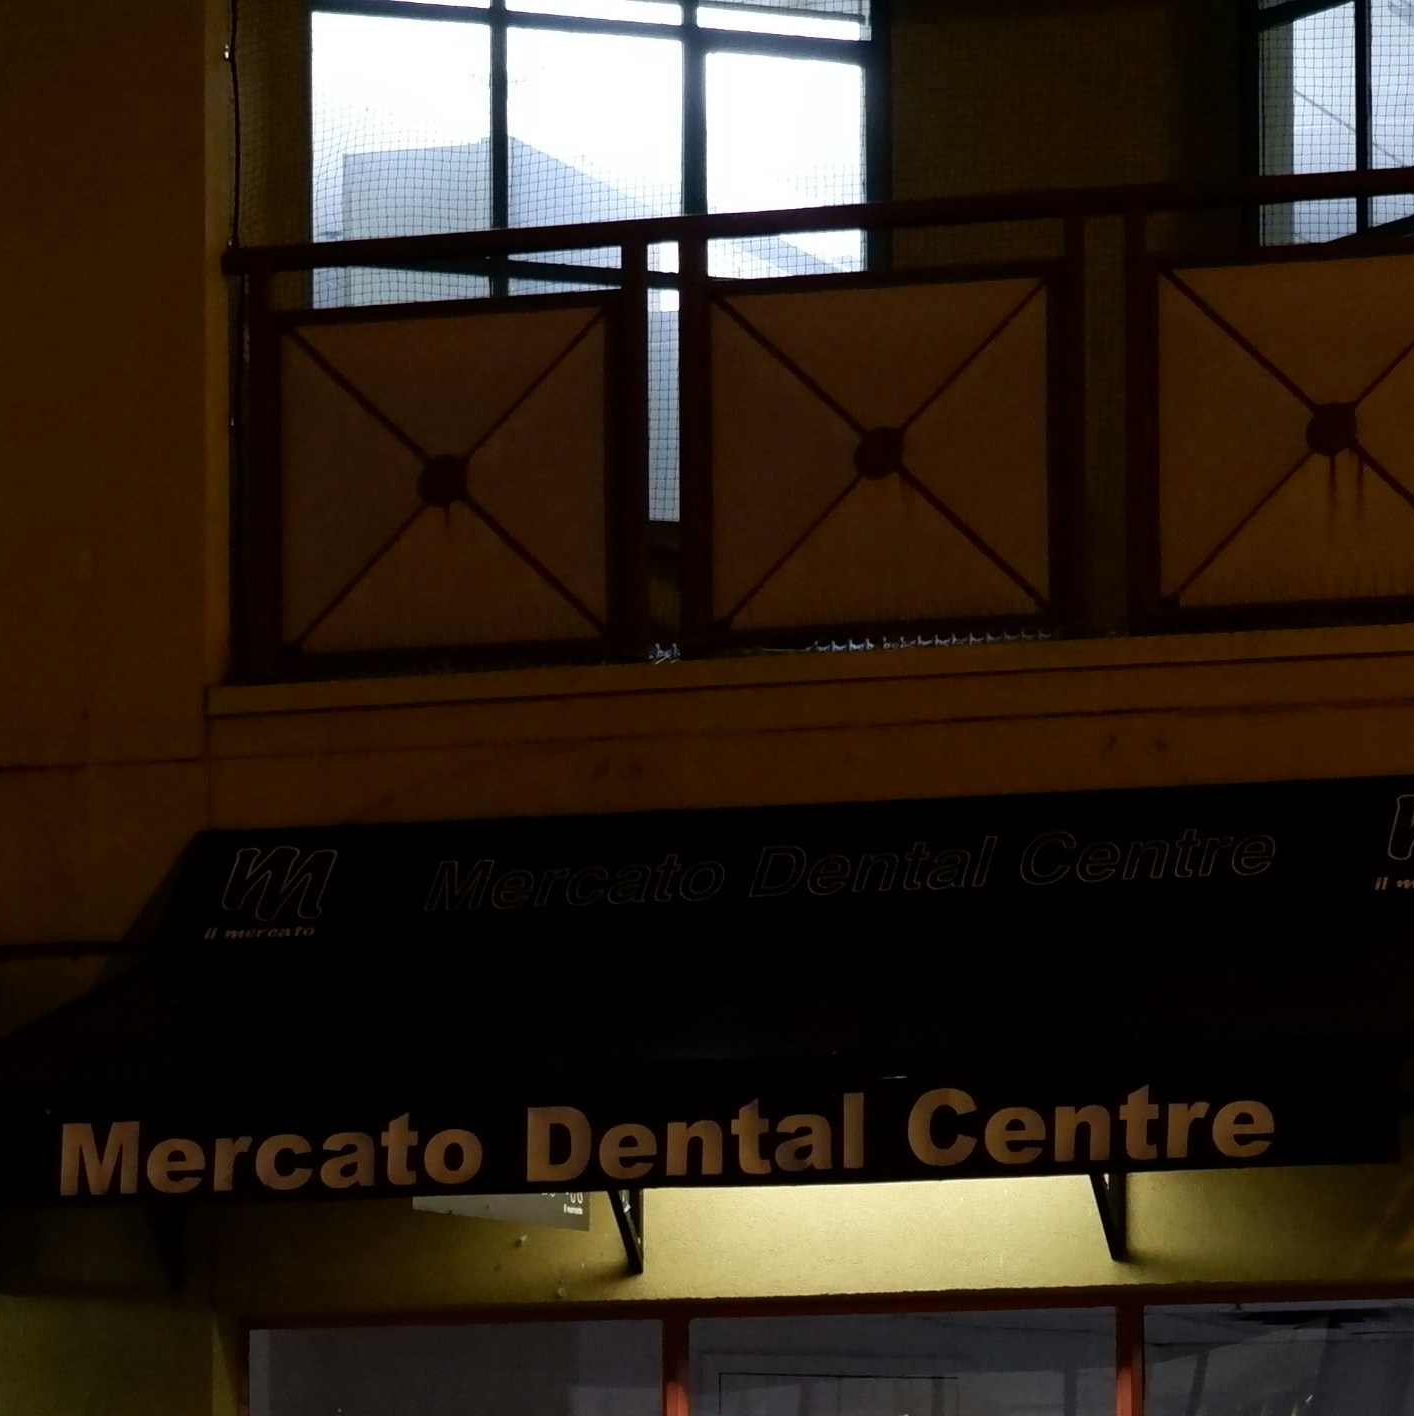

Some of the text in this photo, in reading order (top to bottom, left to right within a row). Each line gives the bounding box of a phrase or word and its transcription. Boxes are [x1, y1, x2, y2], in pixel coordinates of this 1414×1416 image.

[424, 827, 1276, 912] Mercato Dental Centre
[223, 924, 316, 940] mercato
[58, 1082, 1275, 1198] Mercato Dental Centre
